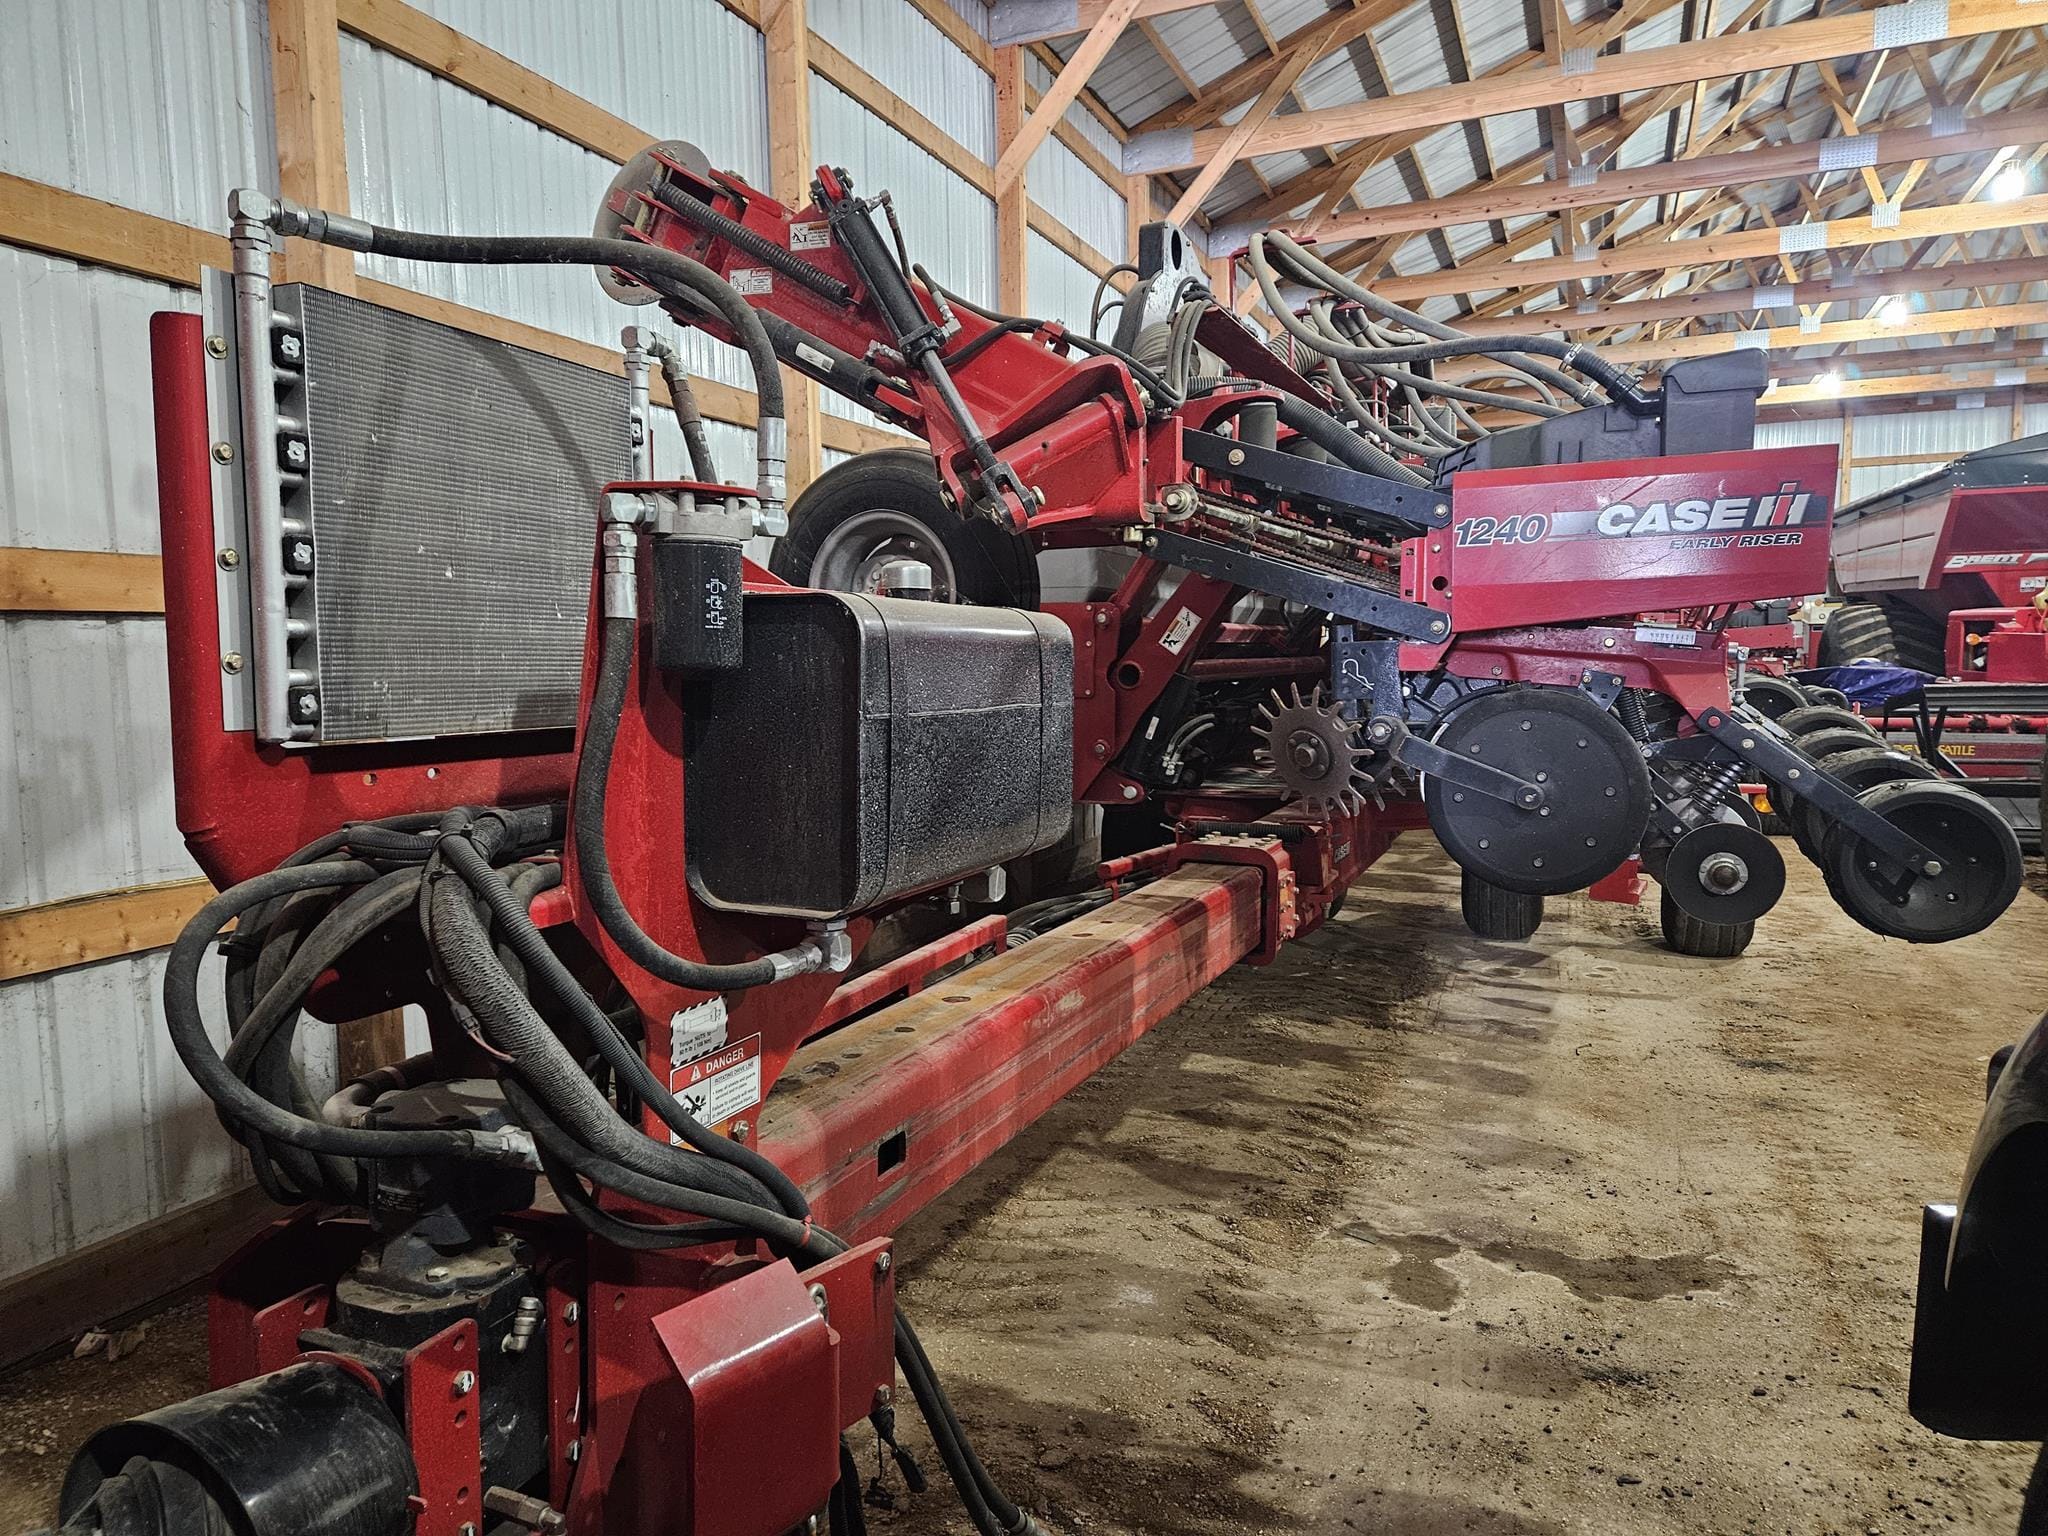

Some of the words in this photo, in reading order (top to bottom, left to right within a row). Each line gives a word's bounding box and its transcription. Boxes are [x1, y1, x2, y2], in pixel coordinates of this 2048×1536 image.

[1455, 514, 1548, 548] 1240
[1597, 498, 1751, 536] CASE
[1670, 534, 1735, 549] EARLY
[1738, 532, 1803, 547] RISER
[706, 1048, 744, 1074] DANGER
